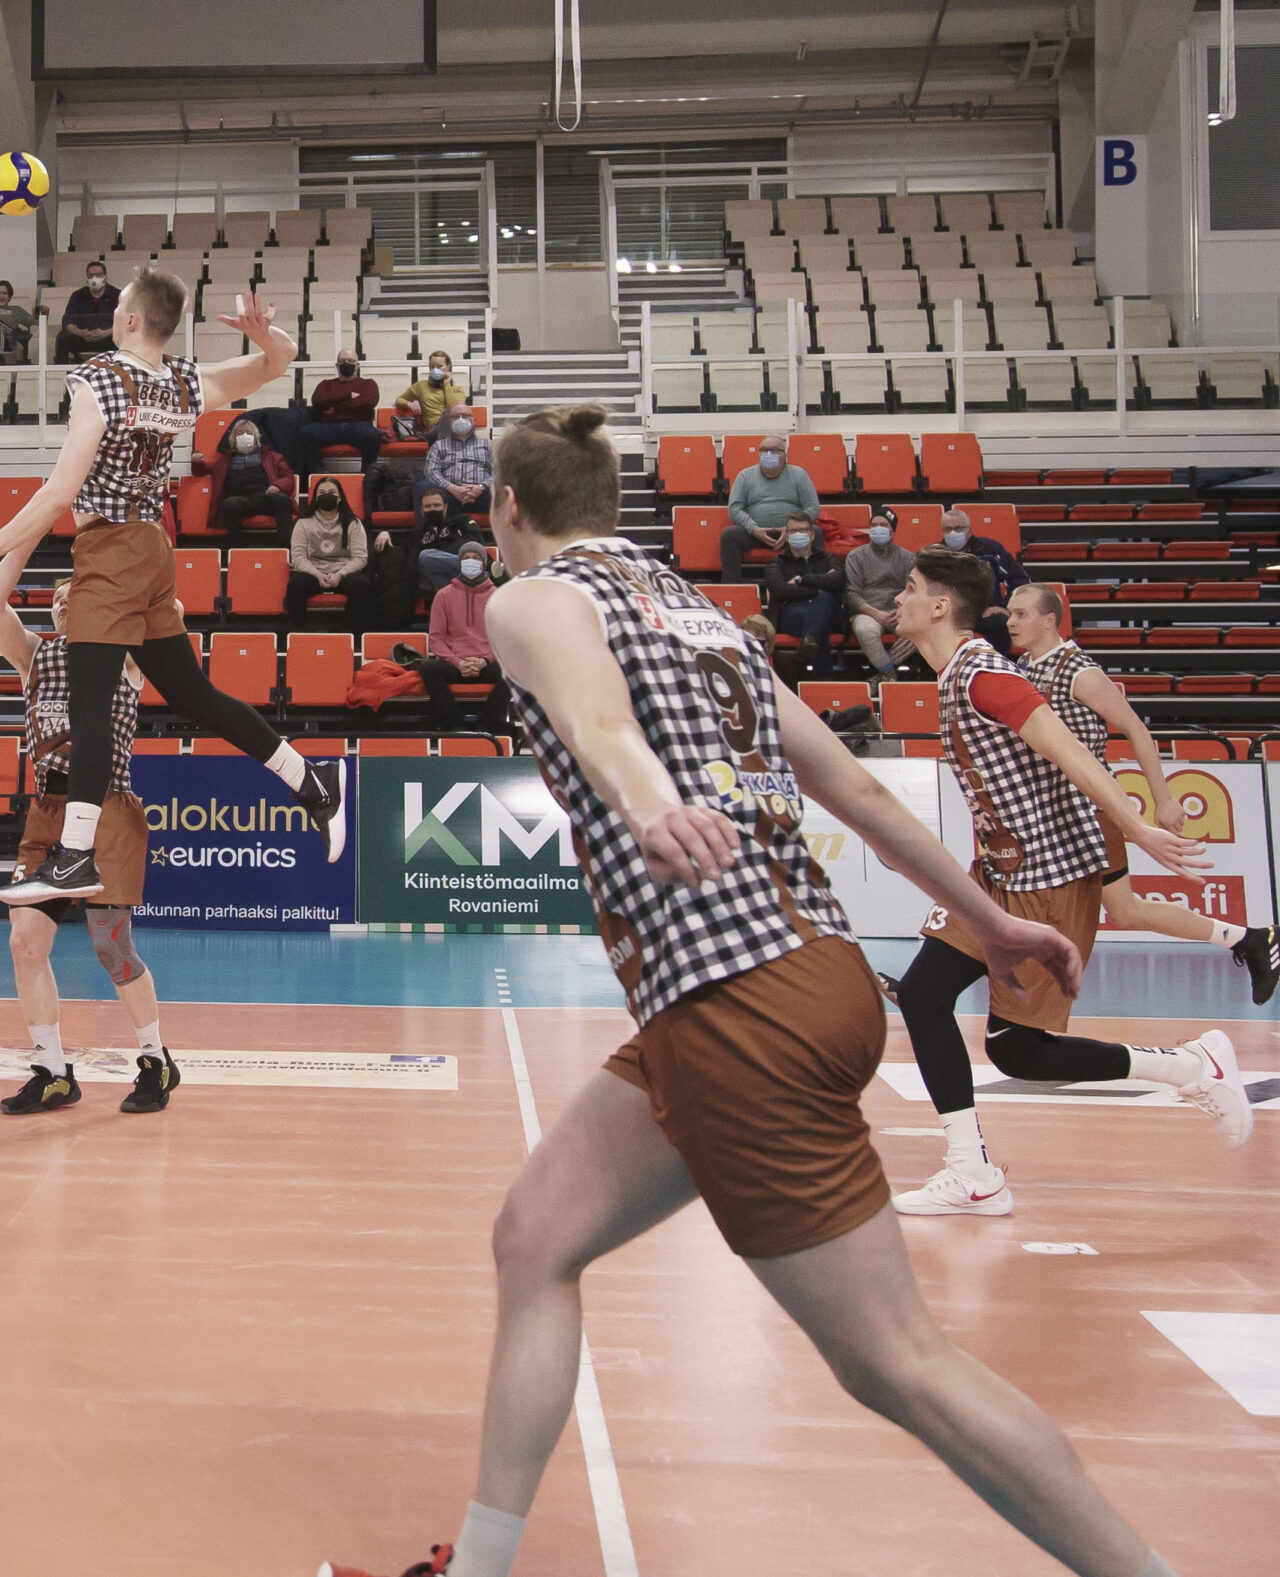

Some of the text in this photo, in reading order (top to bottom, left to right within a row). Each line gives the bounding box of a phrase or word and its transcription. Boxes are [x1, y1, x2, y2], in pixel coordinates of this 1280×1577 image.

[1104, 140, 1137, 186] B
[693, 650, 760, 755] 9
[137, 797, 322, 832] alokulm
[404, 782, 578, 867] KM
[170, 842, 296, 867] euronics
[404, 872, 579, 890] Kiinteistömaailma
[205, 905, 277, 921] parhaaksi
[282, 906, 340, 922] palkittu!
[449, 899, 539, 913] Rovaniemi
